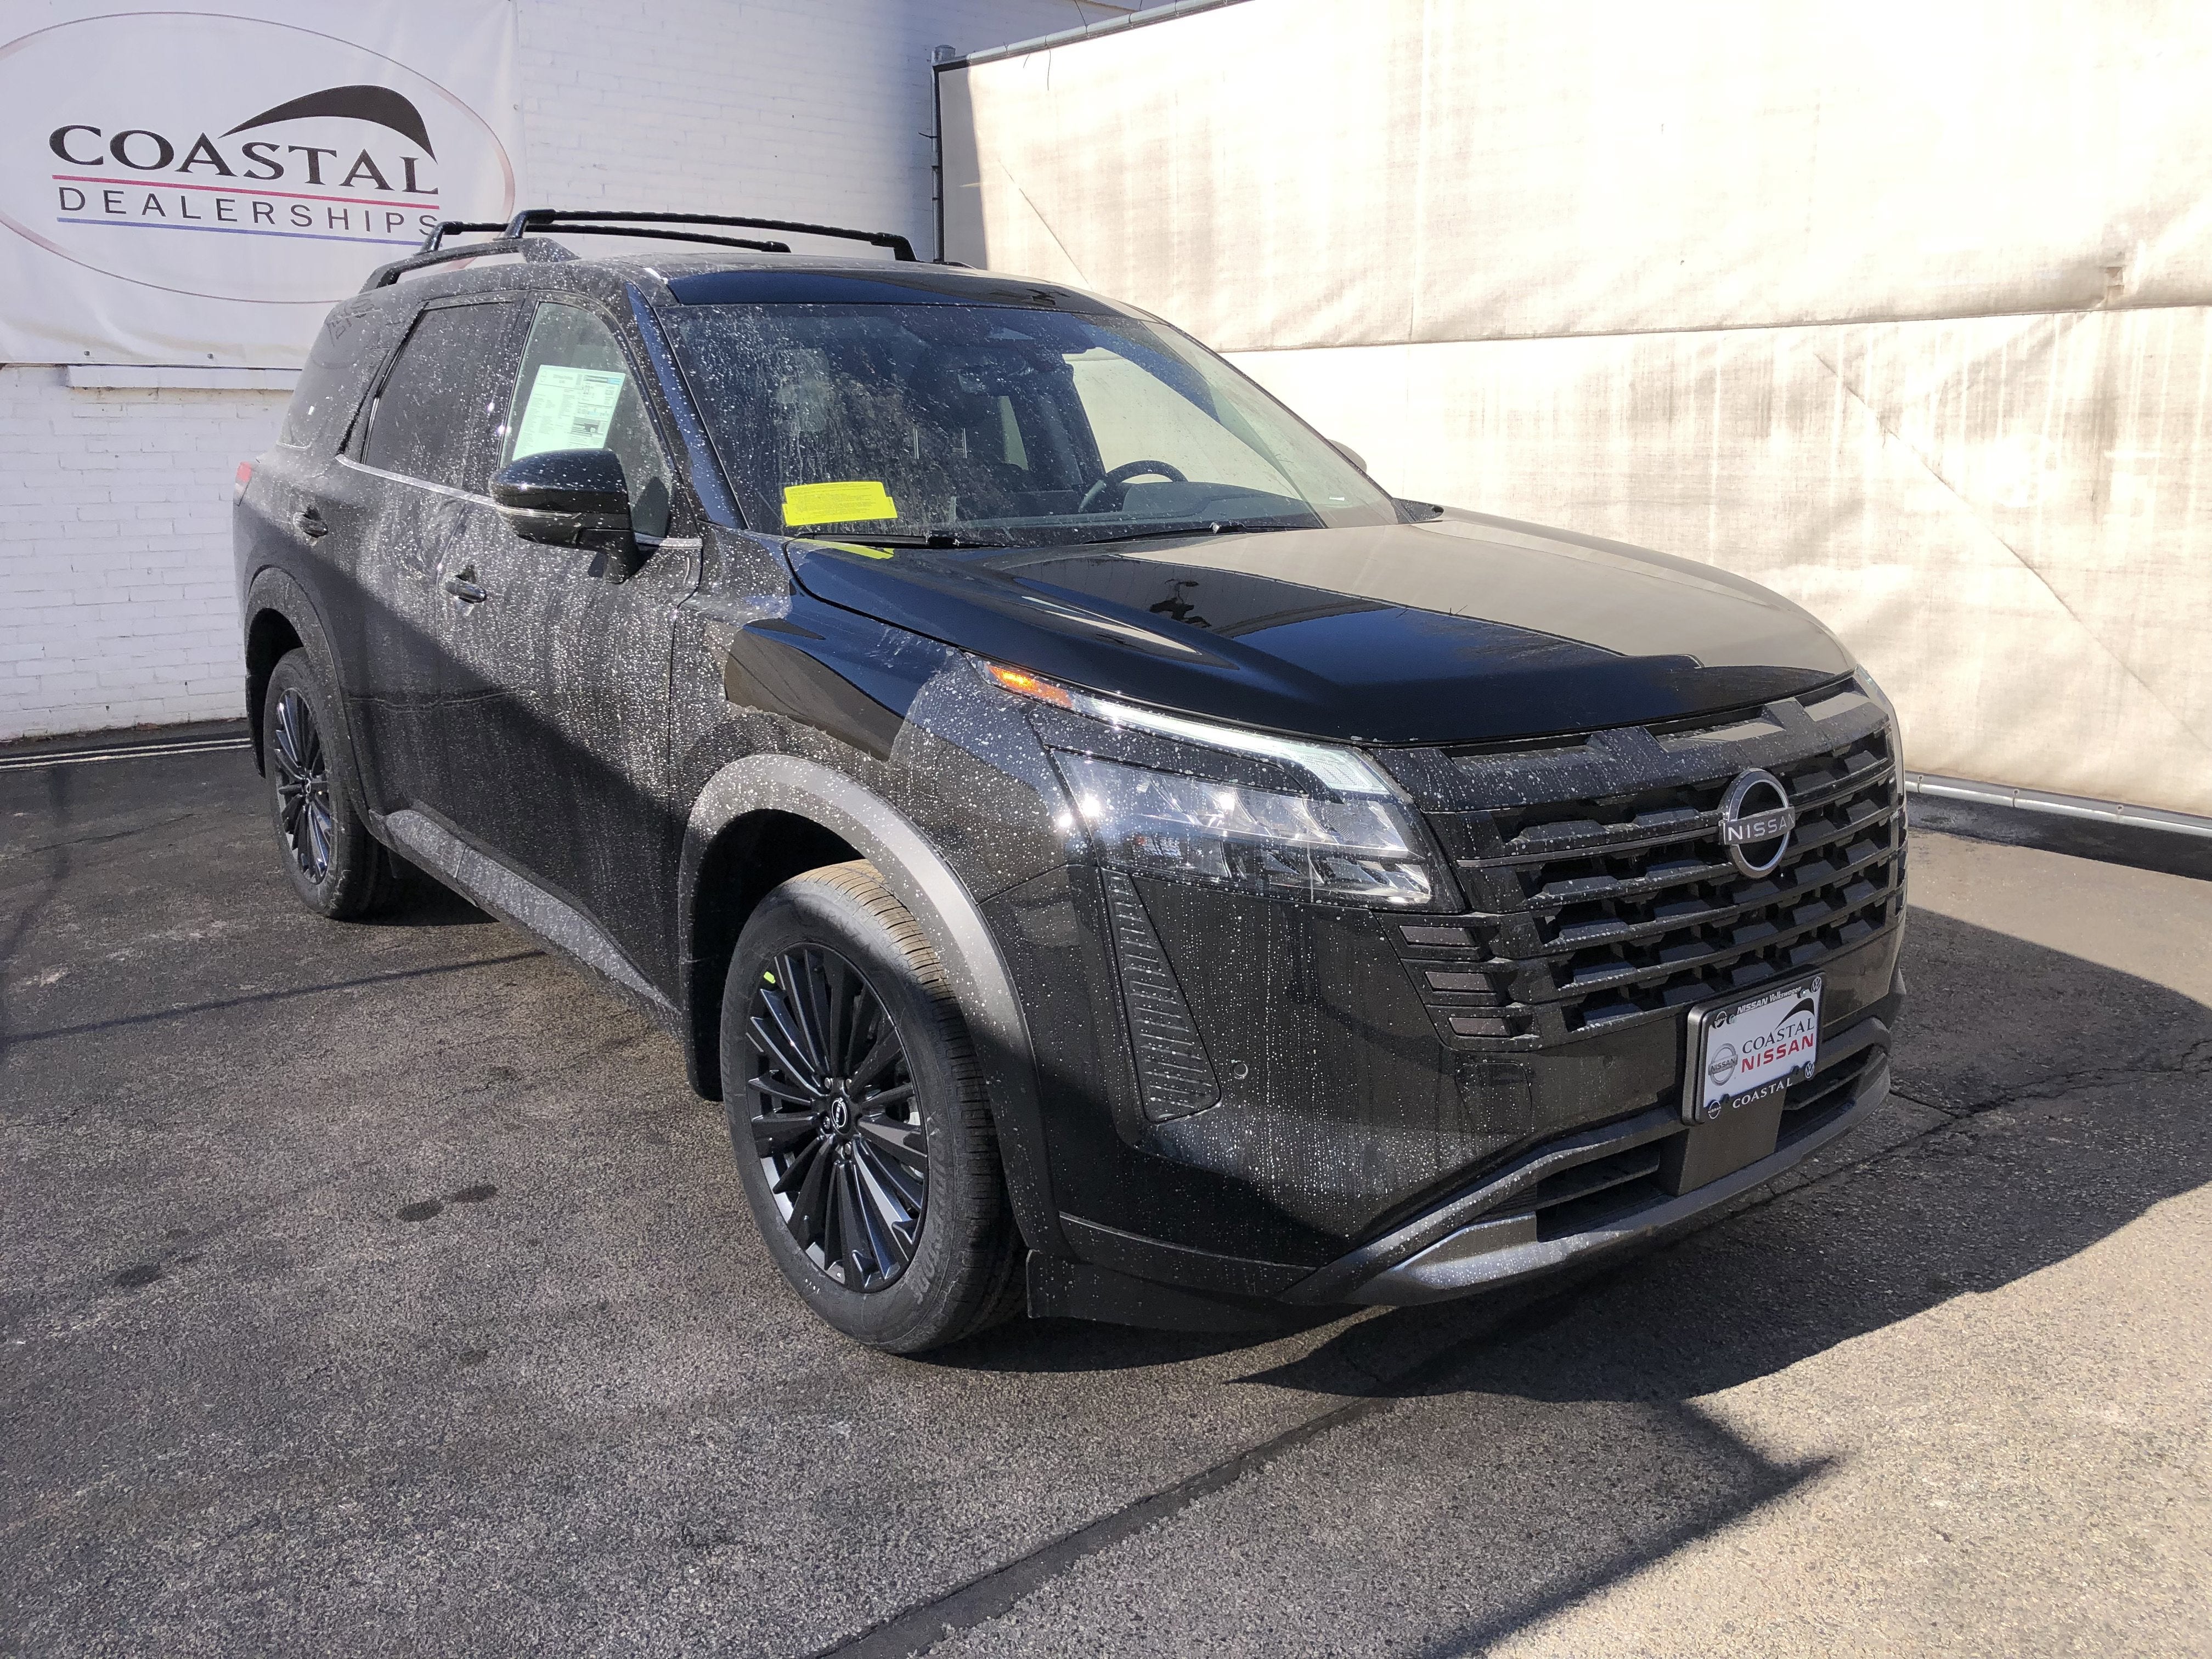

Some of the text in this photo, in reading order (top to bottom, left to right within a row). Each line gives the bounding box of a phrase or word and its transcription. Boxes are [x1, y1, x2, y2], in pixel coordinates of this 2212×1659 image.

[49, 125, 438, 194] COASTAL
[59, 187, 438, 235] DEALERSHIPS
[1728, 813, 1795, 841] NISSAN
[1736, 997, 1768, 1014] NISSAN
[1742, 1018, 1815, 1053] COASTAL
[1711, 1057, 1736, 1071] NISSAN
[1741, 1033, 1814, 1073] NISSAN
[1733, 1077, 1793, 1108] COASTAL
